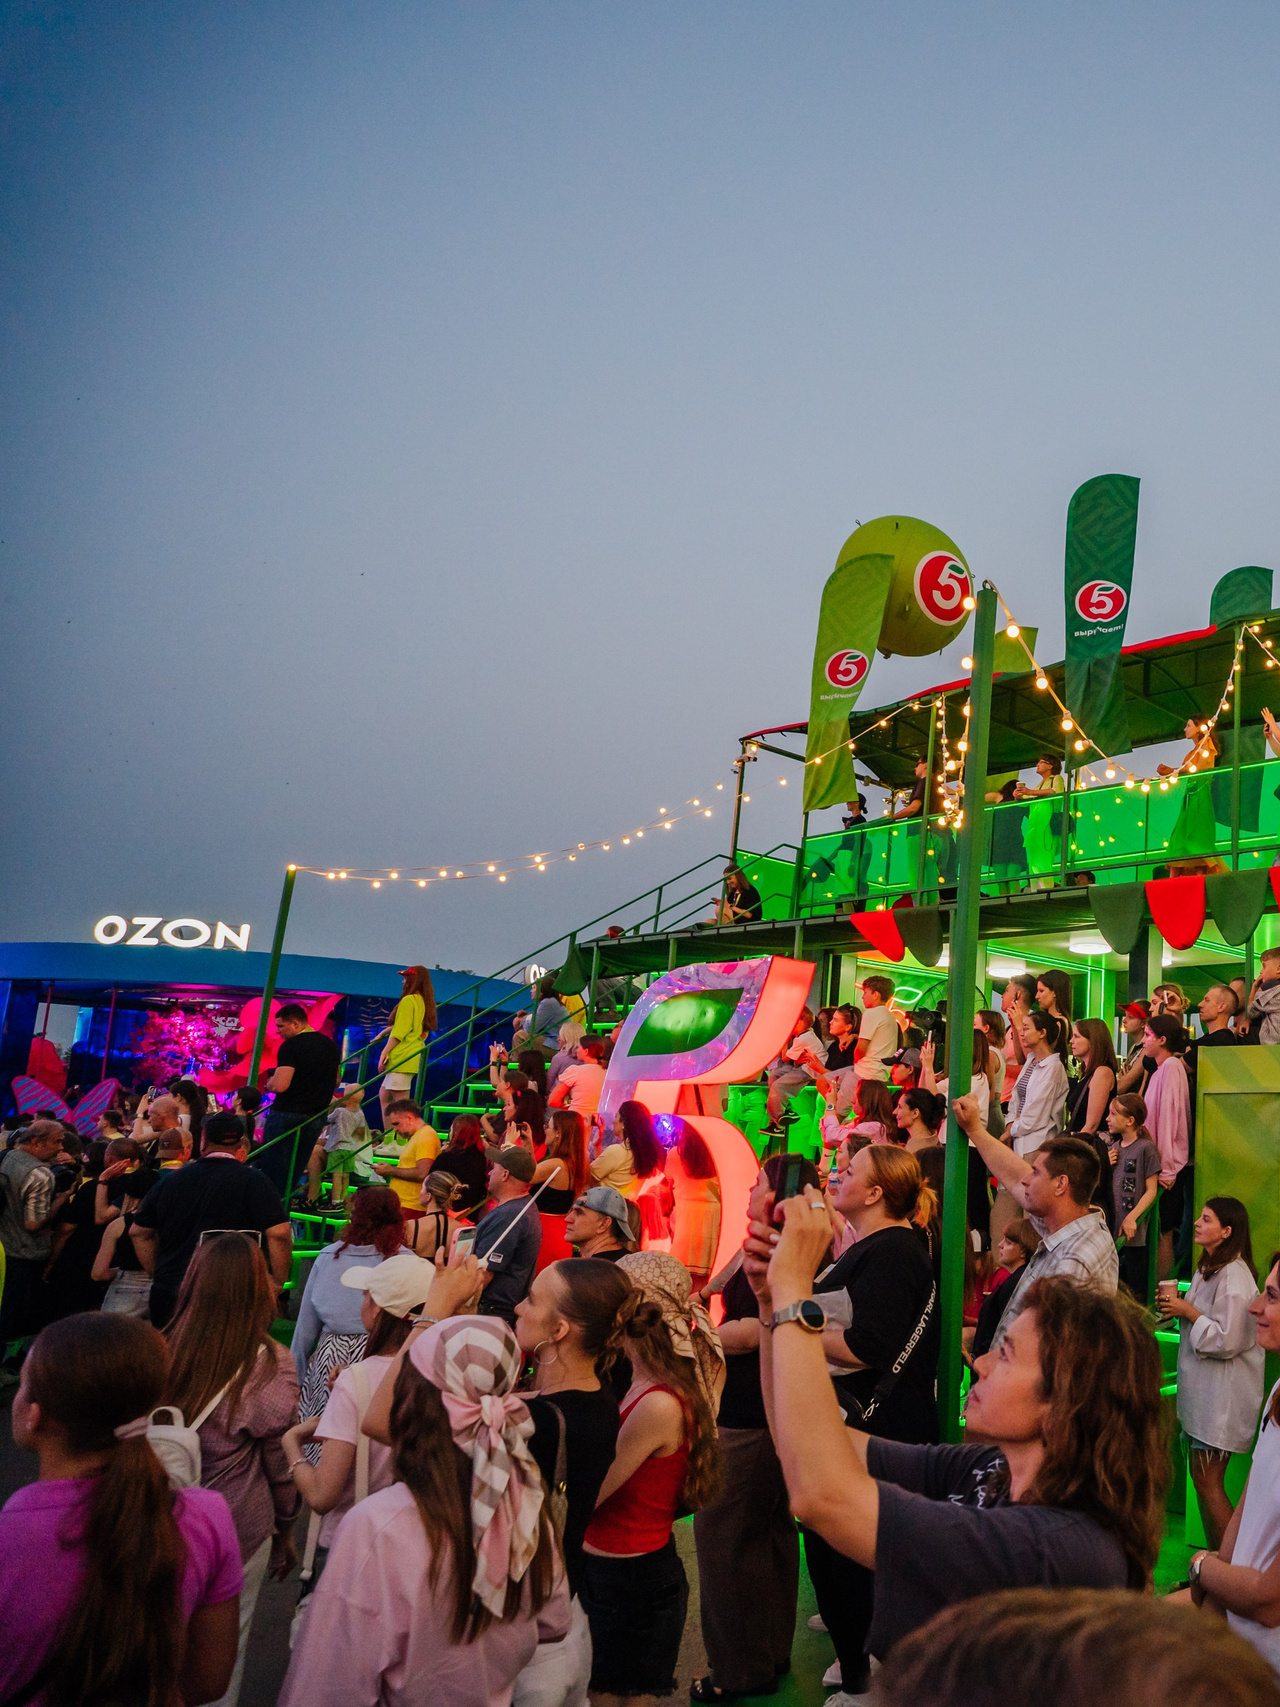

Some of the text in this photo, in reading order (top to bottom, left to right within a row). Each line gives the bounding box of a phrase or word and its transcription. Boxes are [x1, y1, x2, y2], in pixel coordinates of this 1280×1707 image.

[932, 560, 967, 610] 5
[1089, 584, 1117, 615] 5
[836, 652, 863, 682] 5
[94, 915, 250, 951] OZON
[892, 1313, 929, 1374] LAGERFELD
